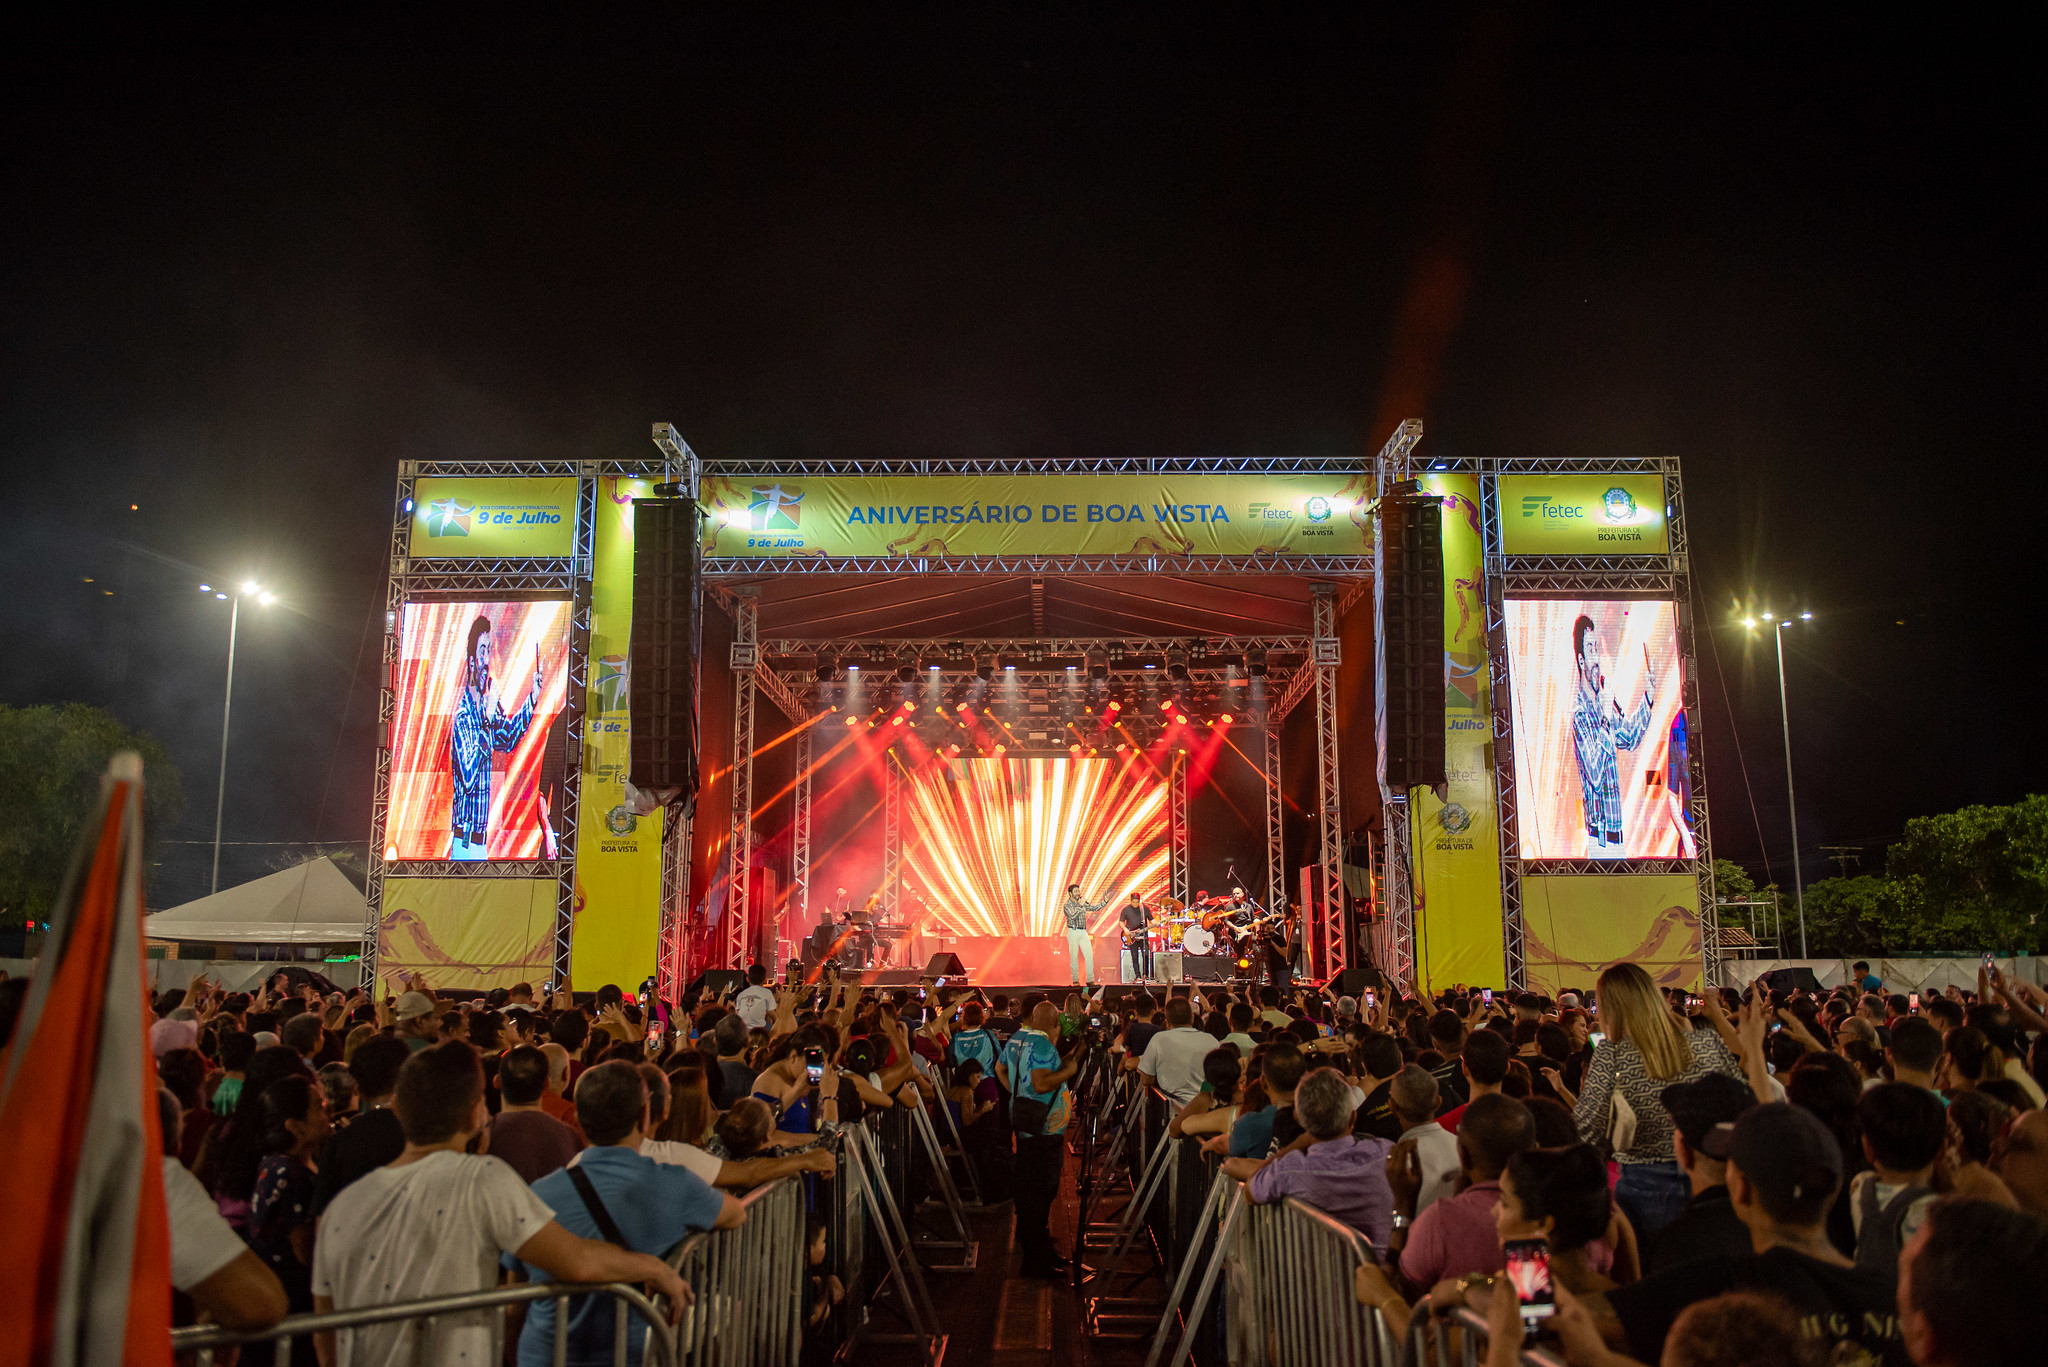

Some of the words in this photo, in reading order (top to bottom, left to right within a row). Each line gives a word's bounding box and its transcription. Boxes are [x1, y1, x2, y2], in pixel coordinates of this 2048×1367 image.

[847, 501, 1033, 525] ANIVERSÁRIO
[1042, 504, 1078, 523] DE
[1087, 504, 1146, 523] BOA
[1152, 504, 1230, 523] VISTA
[1263, 507, 1293, 519] fetec
[1542, 502, 1584, 518] fetec
[478, 511, 490, 524] 9
[492, 511, 513, 524] de
[516, 511, 561, 524] Julho
[747, 538, 756, 547] 9
[757, 538, 772, 547] de
[773, 538, 804, 547] Julho
[1598, 533, 1616, 541] BOA
[1617, 533, 1642, 541] VISTA
[592, 721, 602, 732] 9
[604, 721, 622, 732] de
[1447, 719, 1485, 730] Julho
[1447, 769, 1479, 782] etec
[601, 845, 617, 853] BOA
[617, 845, 638, 853] VISTA
[1436, 843, 1452, 851] BOA
[1452, 843, 1474, 851] VISTA
